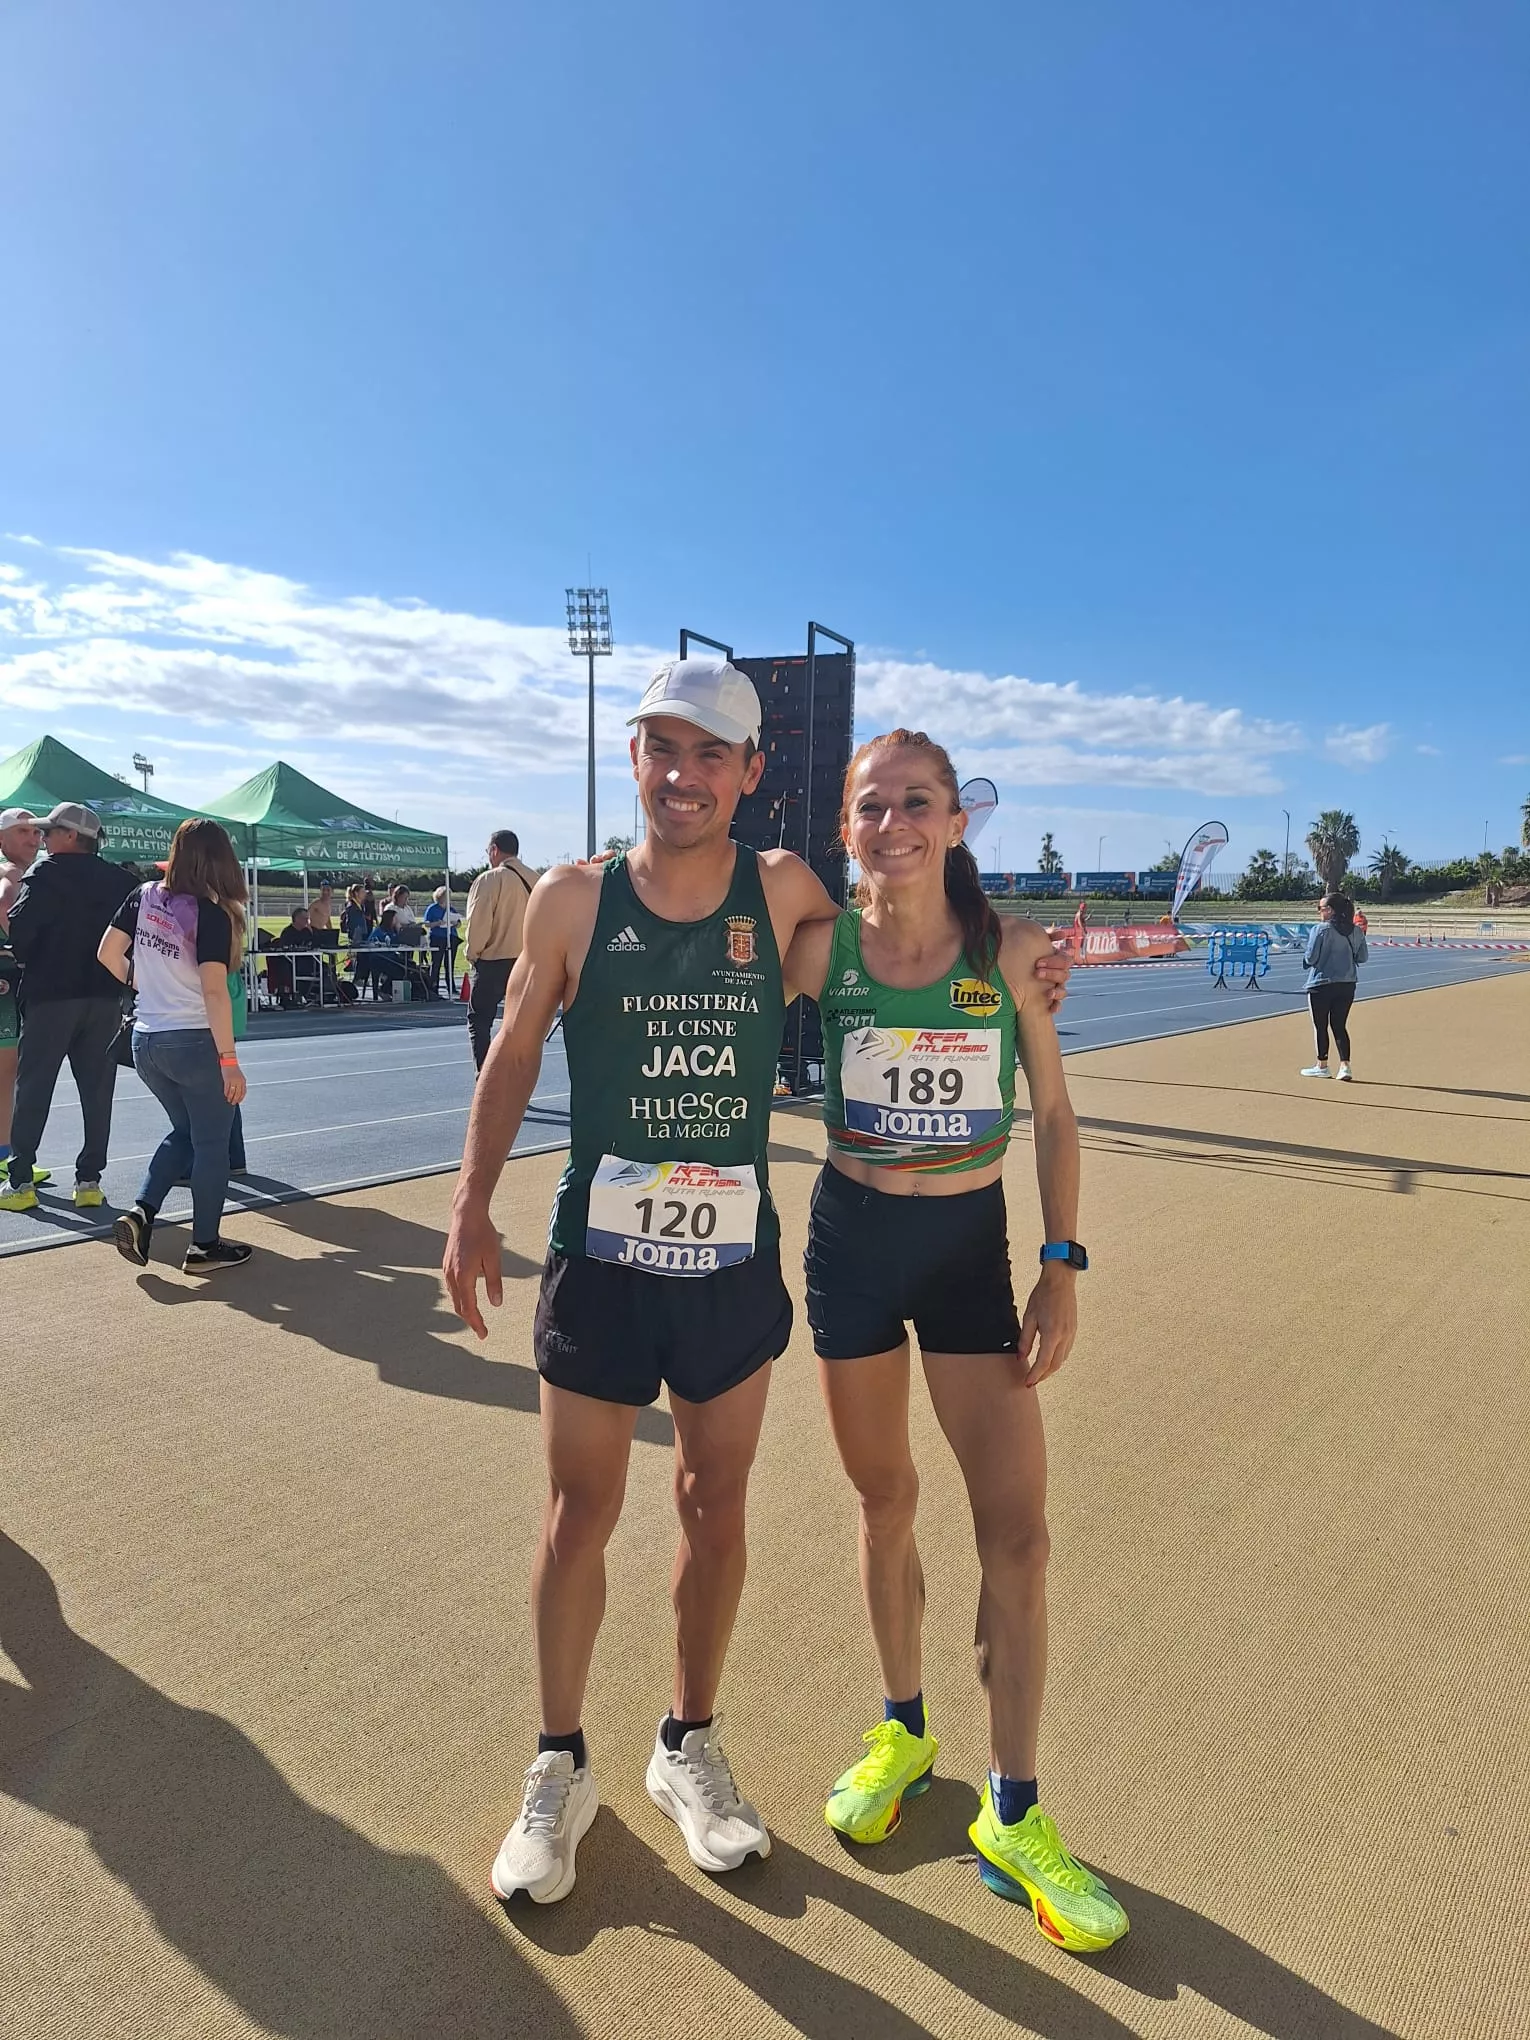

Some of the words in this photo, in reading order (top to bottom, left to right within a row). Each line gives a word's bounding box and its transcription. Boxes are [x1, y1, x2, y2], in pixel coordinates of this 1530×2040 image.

[337, 840, 392, 851] FEDERACIÓN
[395, 846, 442, 854] ANDALUZA
[337, 851, 348, 859] DE
[352, 852, 400, 862] ATLETISMO
[607, 942, 646, 951] adidas
[1086, 931, 1119, 954] oma
[711, 970, 765, 980] AYUNTAMIENTO
[828, 986, 870, 997] VIATOR
[622, 992, 759, 1013] FLORISTERÍA
[838, 1015, 876, 1027] ZOITI
[646, 1020, 673, 1037] EL
[678, 1020, 736, 1037] CISNE
[917, 1032, 968, 1044] RFEA
[912, 1044, 988, 1053] ATLETISMO
[641, 1045, 736, 1078] JACA
[907, 1054, 940, 1062] RUTA
[943, 1055, 991, 1063] RUNNING
[882, 1067, 964, 1105] 189
[674, 1165, 719, 1178] RFEA
[668, 1177, 741, 1187] ATLETISMO
[662, 1186, 695, 1196] RUTA
[698, 1188, 746, 1196] RUNNING
[634, 1198, 717, 1239] 120
